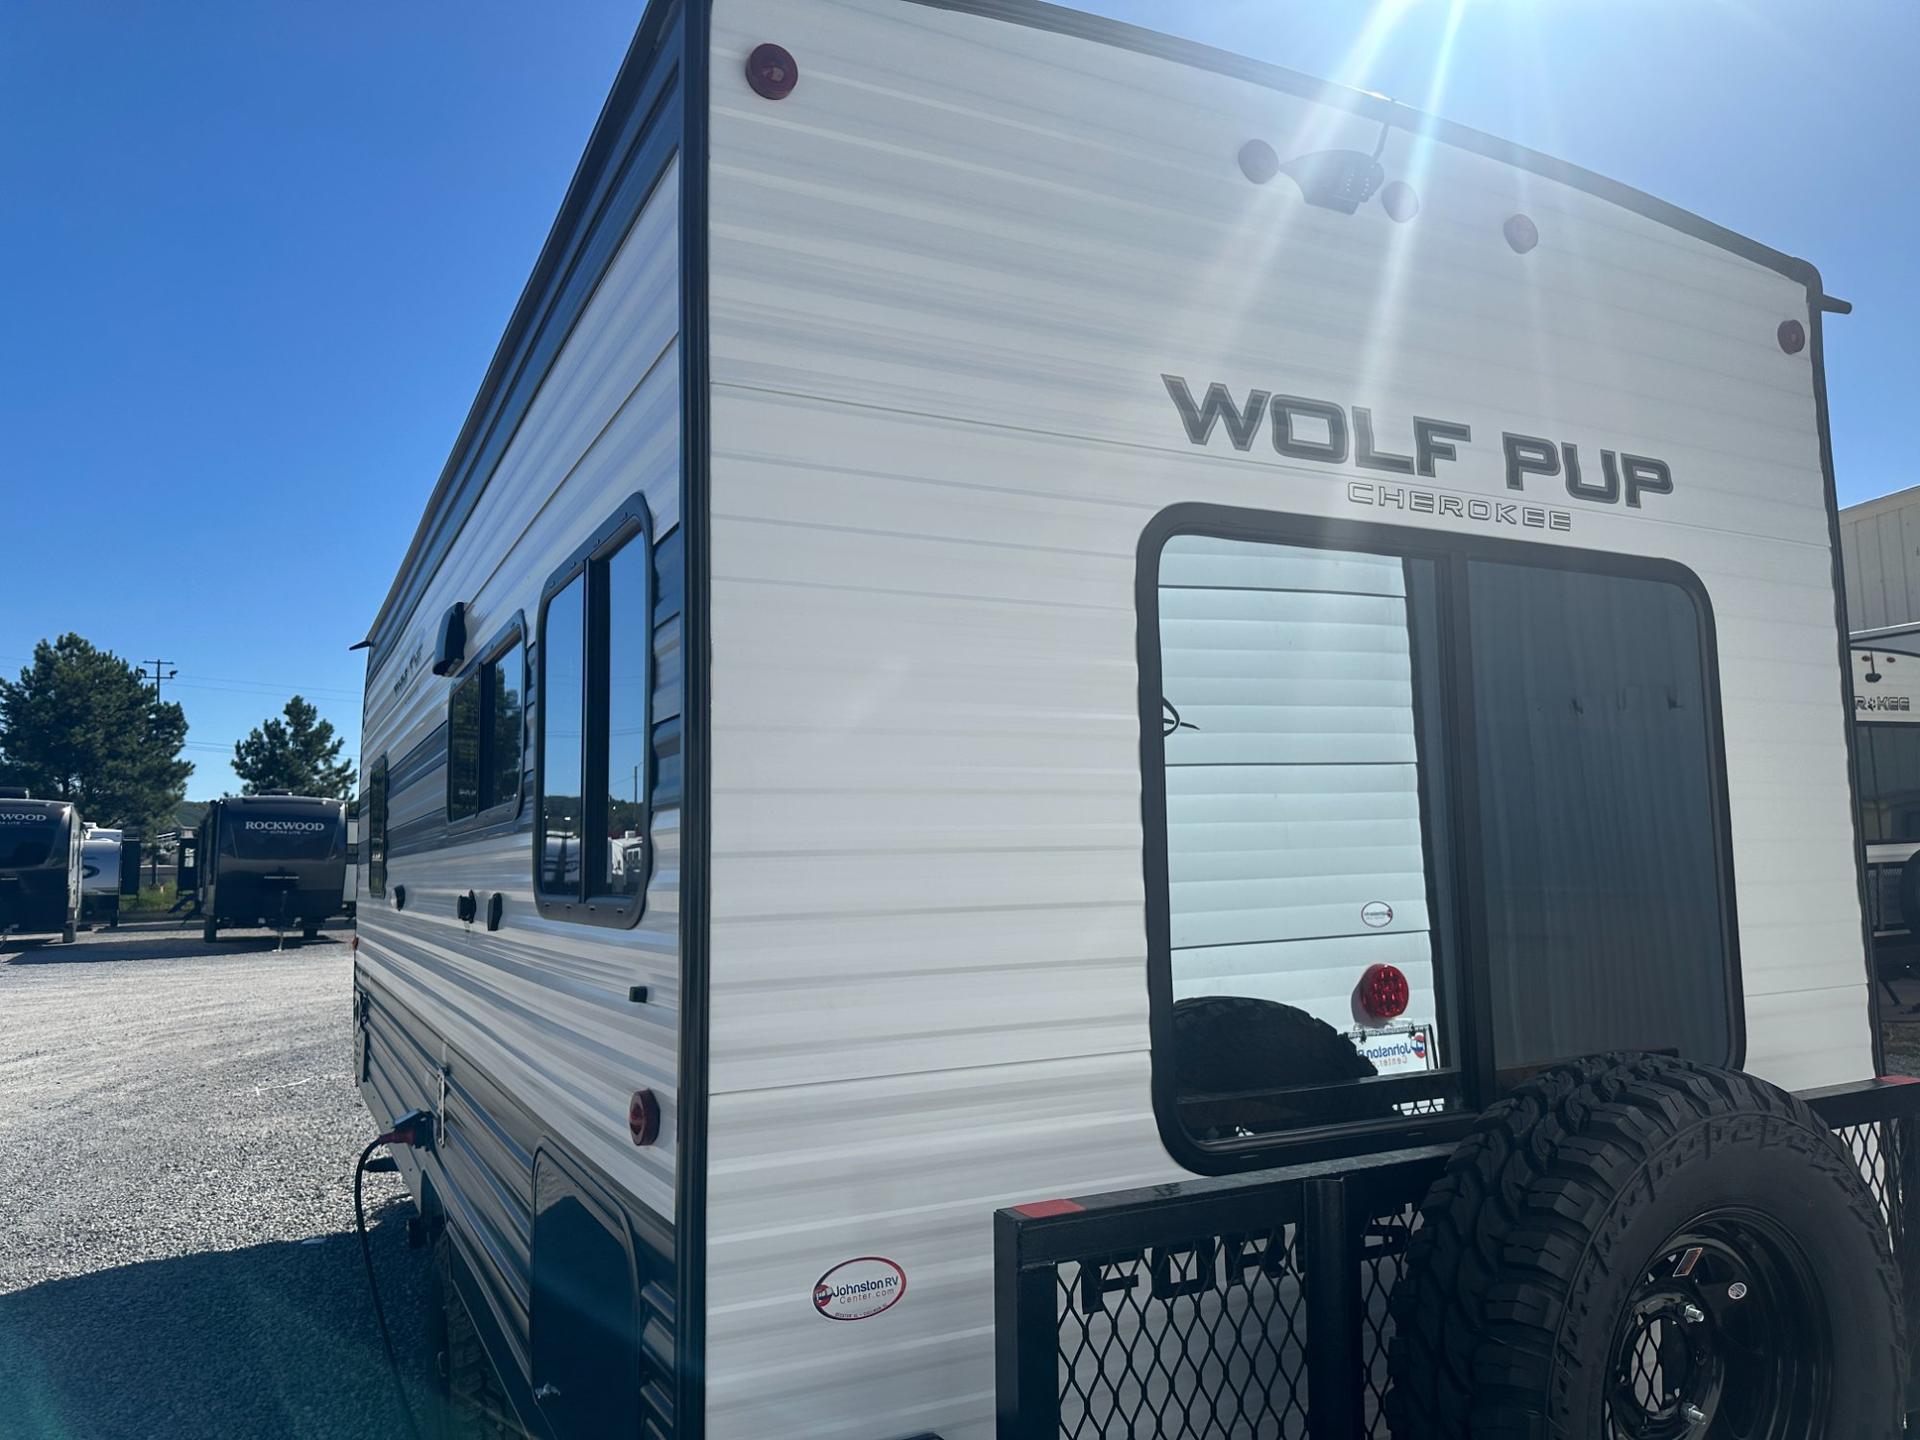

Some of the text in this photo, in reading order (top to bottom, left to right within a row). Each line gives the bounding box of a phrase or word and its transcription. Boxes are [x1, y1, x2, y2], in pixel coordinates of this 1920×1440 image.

[1160, 373, 1675, 510] WOLF PUP
[1347, 481, 1572, 532] CHEROKEE
[245, 820, 325, 831] ROCKWOOD
[832, 1276, 899, 1298] Johnston RV
